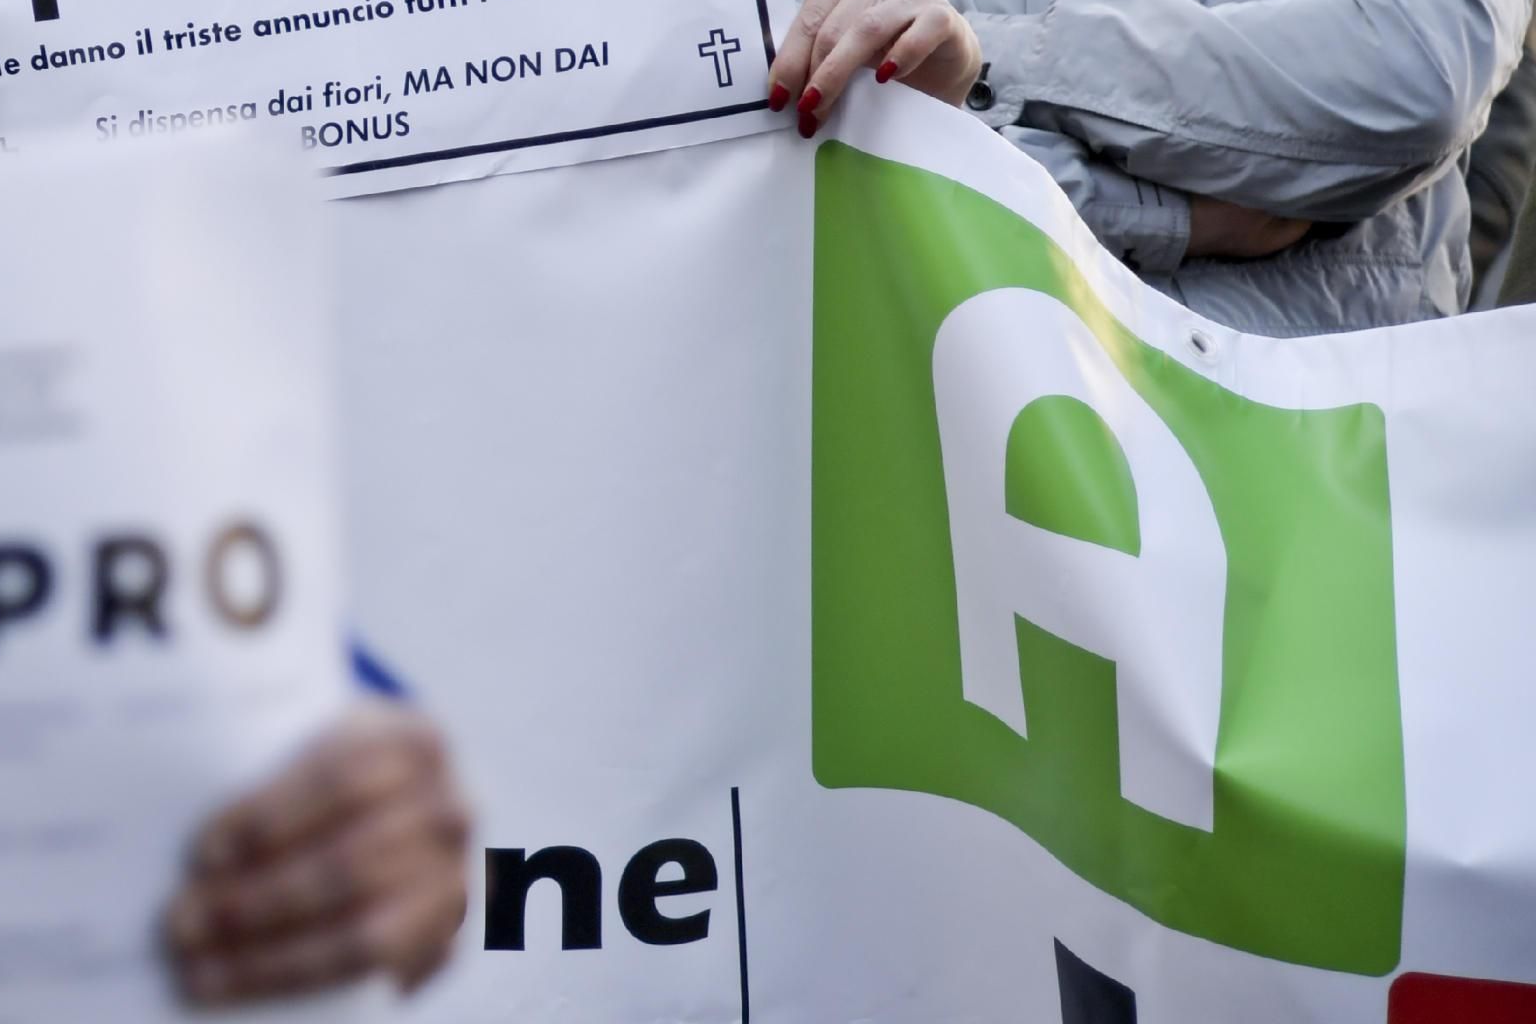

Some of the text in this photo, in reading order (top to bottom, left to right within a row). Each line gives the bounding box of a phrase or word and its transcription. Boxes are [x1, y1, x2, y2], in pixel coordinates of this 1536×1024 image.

[30, 42, 126, 71] danno
[135, 28, 153, 56] il
[163, 22, 242, 51] triste
[96, 41, 609, 143] Si dispensa dai fiori, MA NON DAI
[301, 110, 410, 151] BONUS
